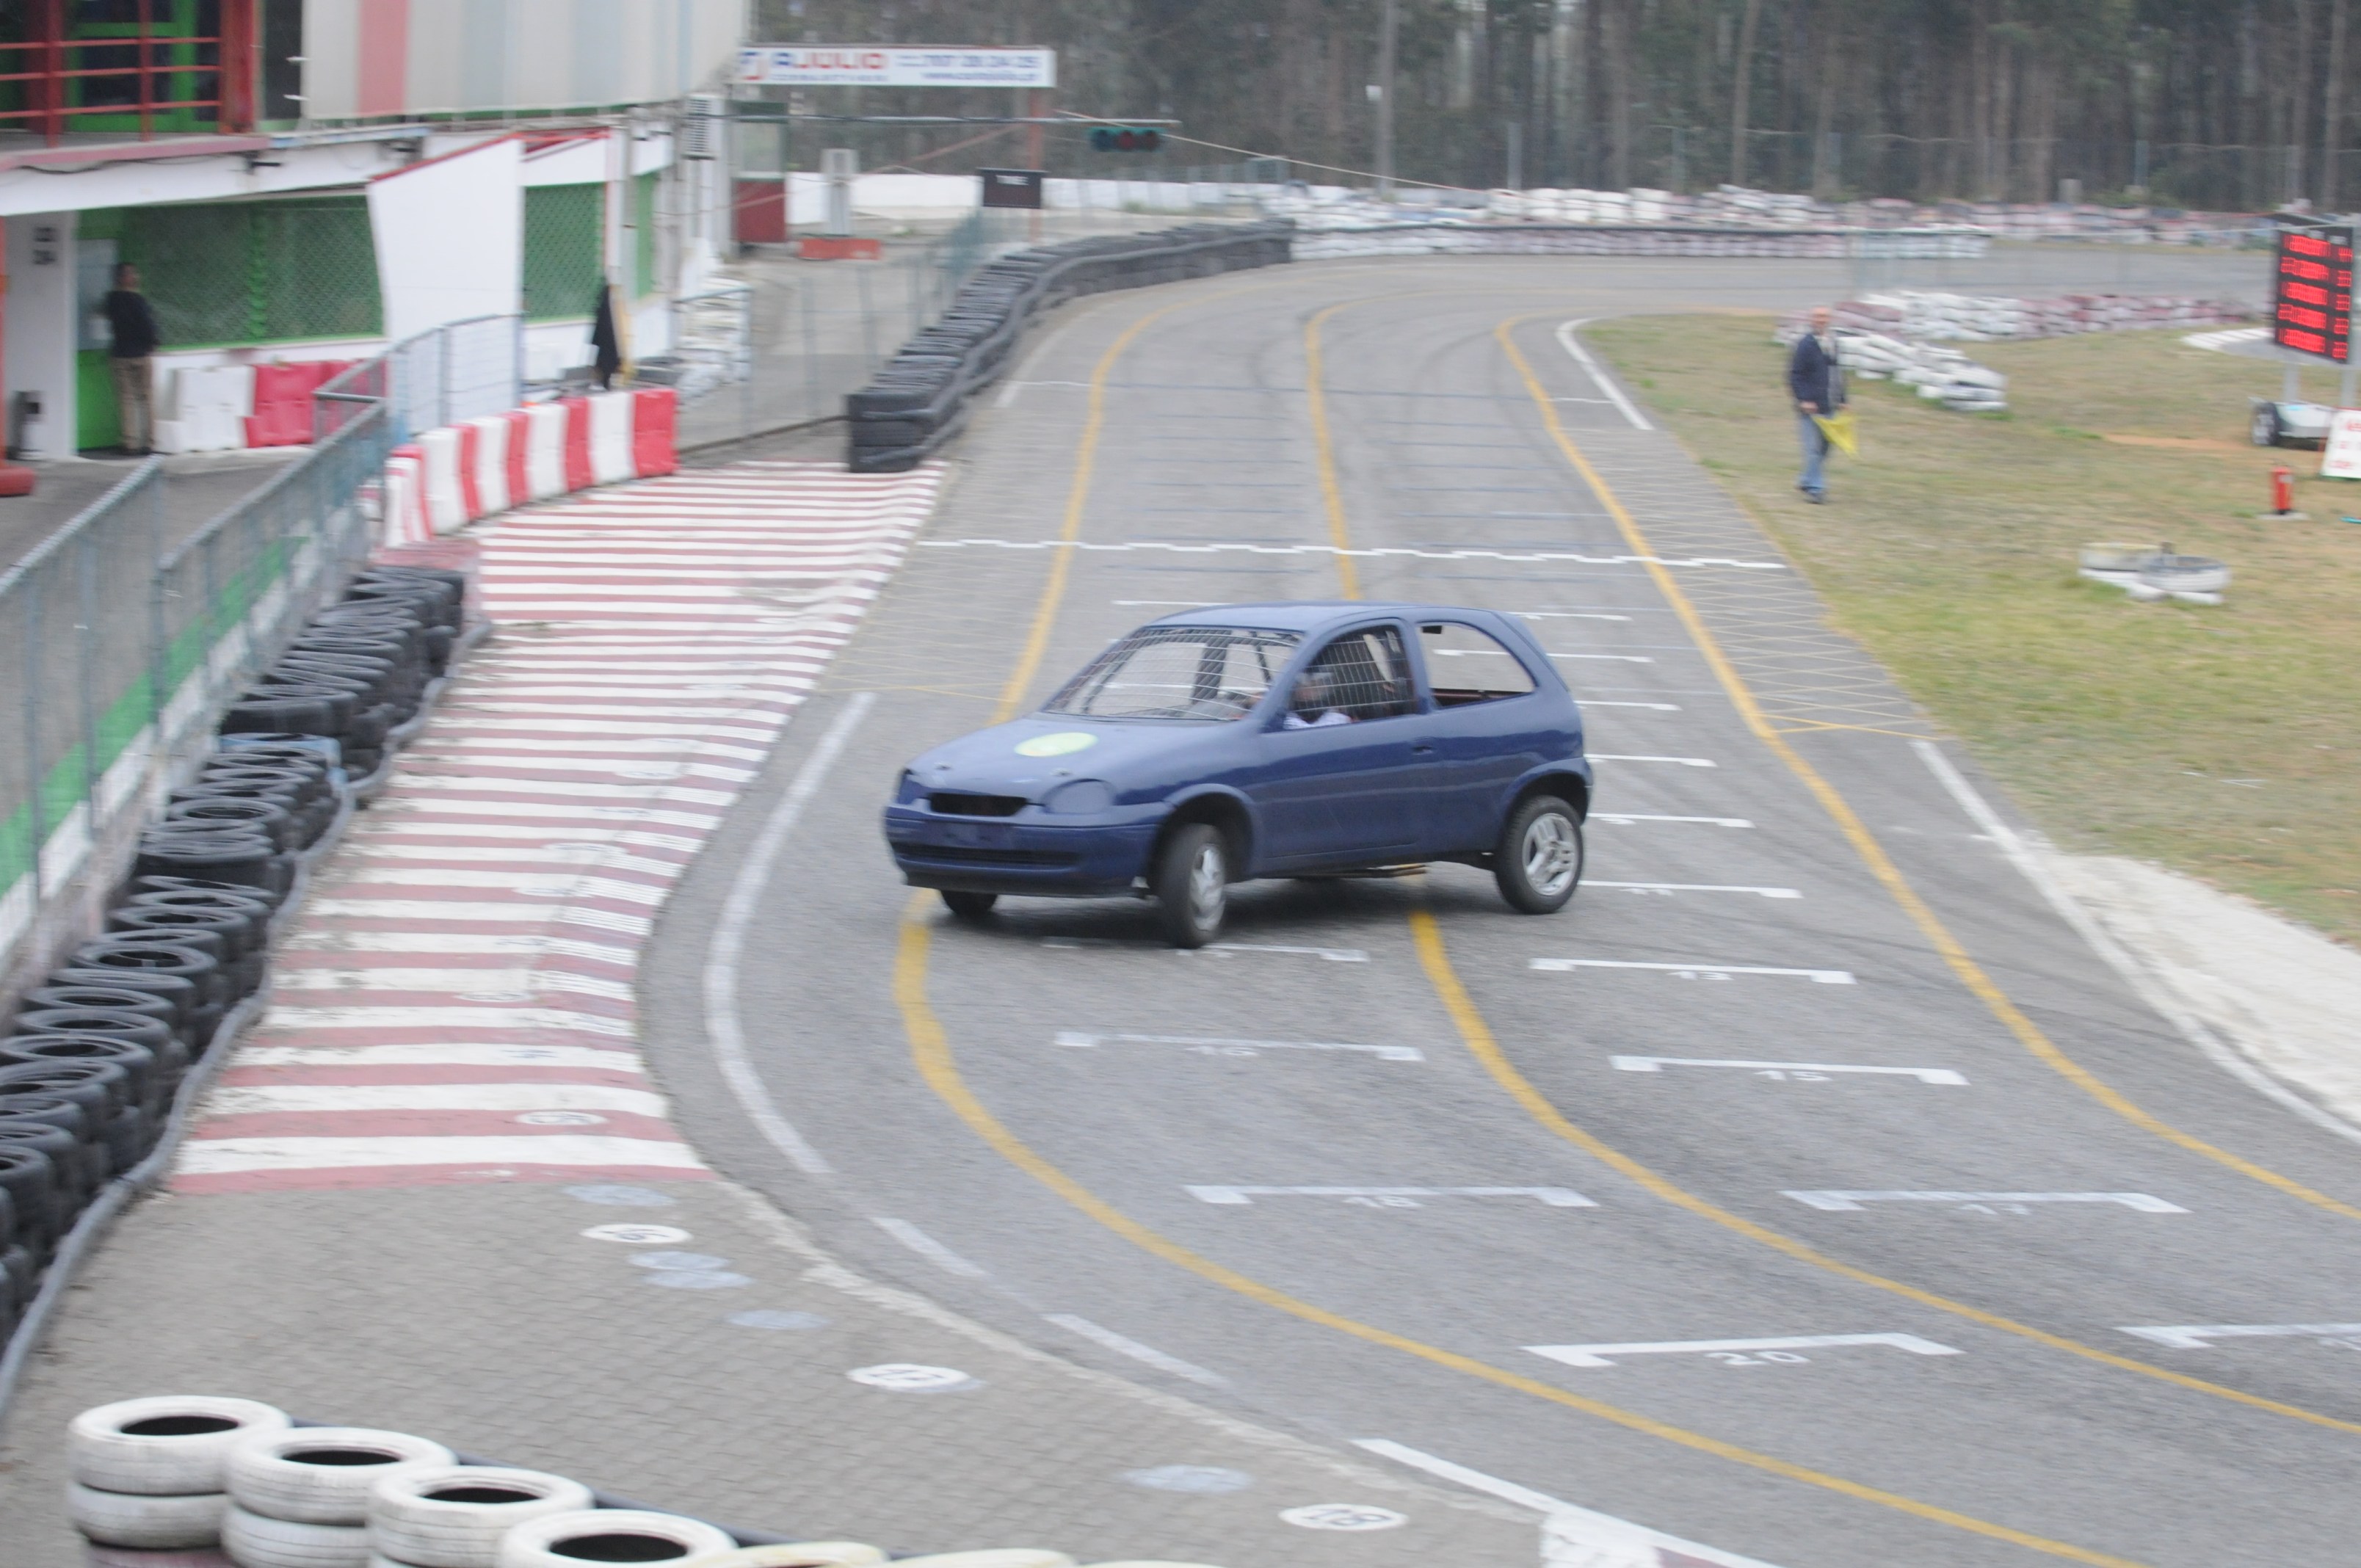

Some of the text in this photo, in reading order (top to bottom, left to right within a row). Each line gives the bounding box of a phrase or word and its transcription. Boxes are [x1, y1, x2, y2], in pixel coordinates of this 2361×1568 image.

[1667, 970, 1735, 981] 13
[1753, 1070, 1834, 1081] 15
[1704, 1351, 1811, 1365] 20
[1301, 1508, 1393, 1527] 18
